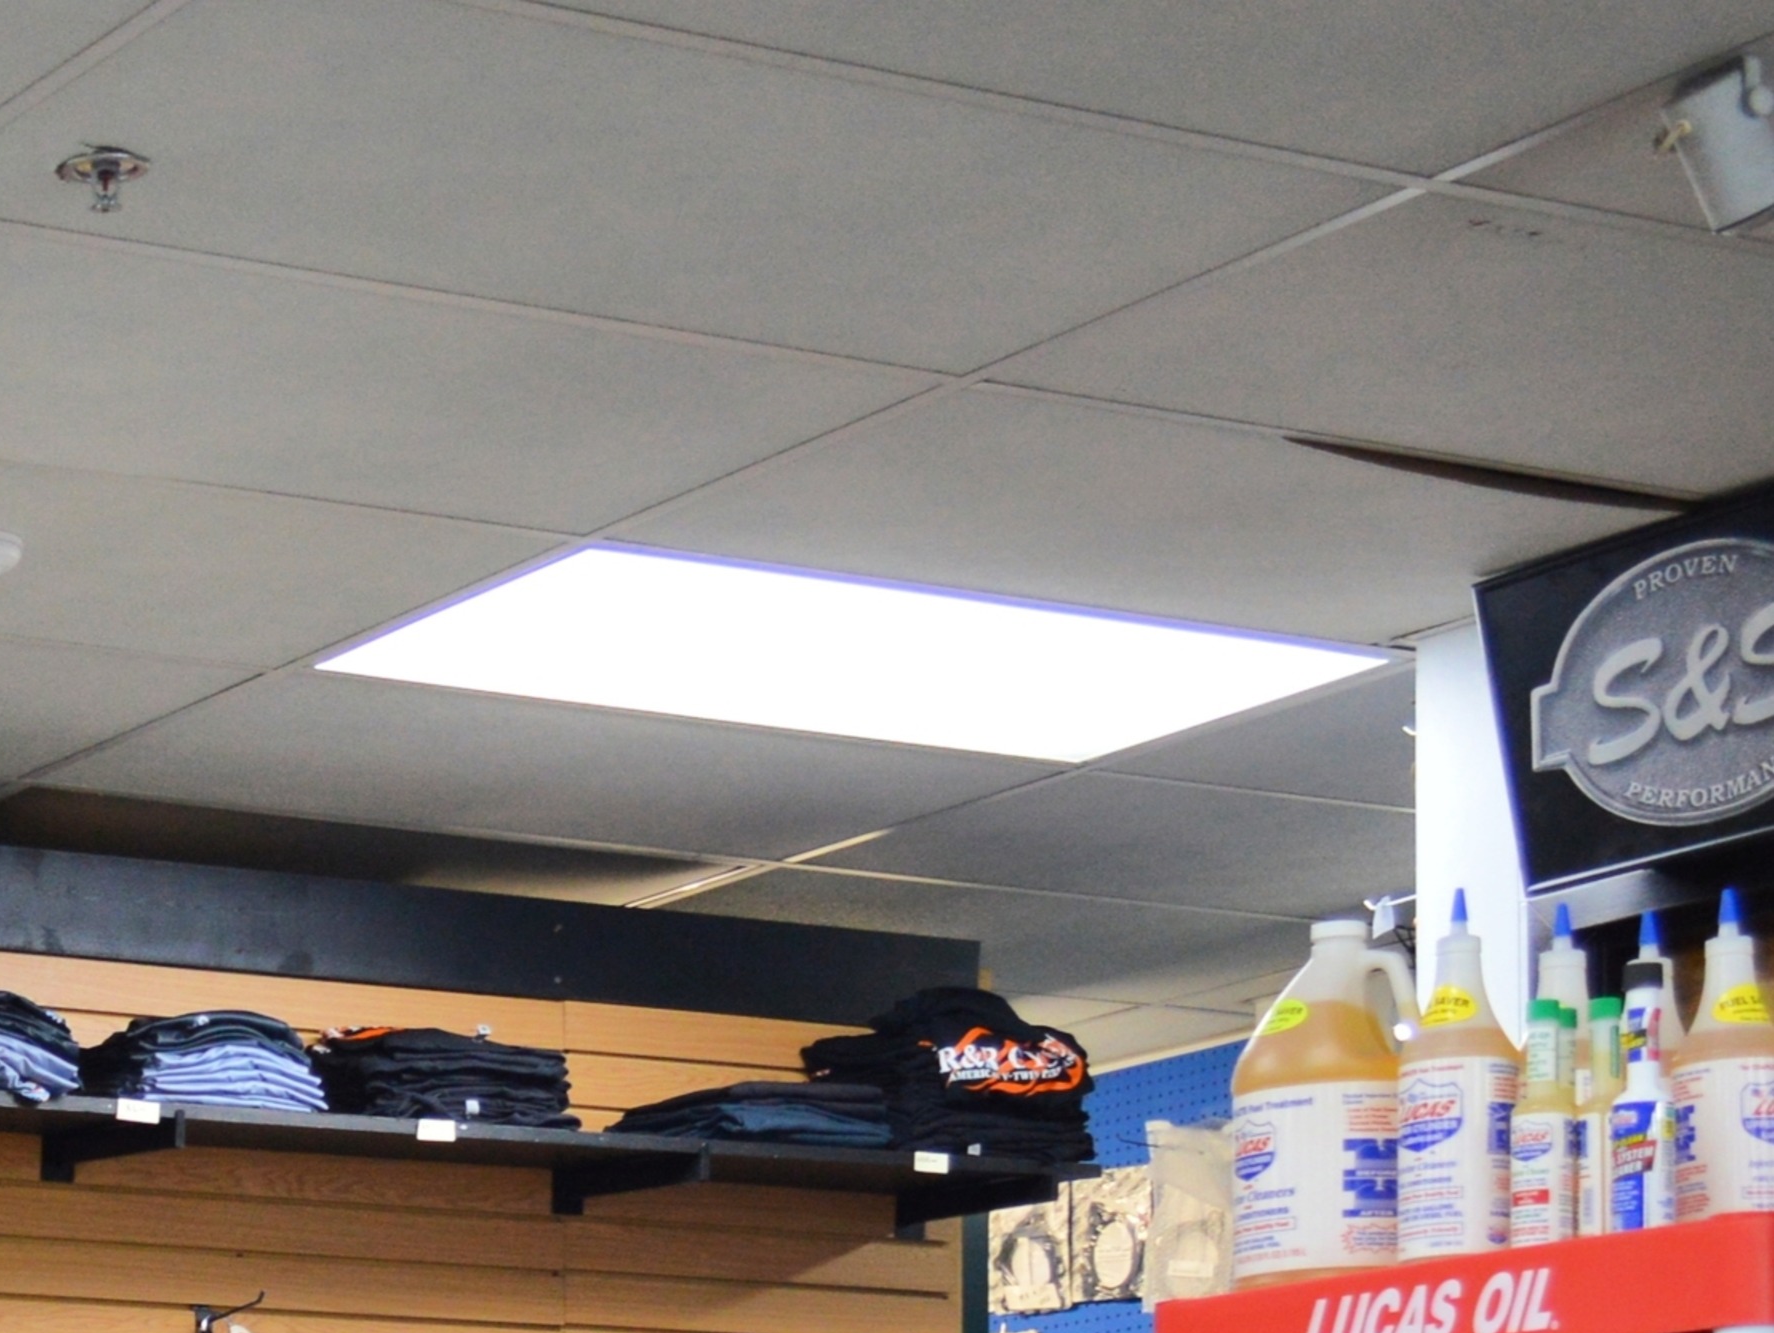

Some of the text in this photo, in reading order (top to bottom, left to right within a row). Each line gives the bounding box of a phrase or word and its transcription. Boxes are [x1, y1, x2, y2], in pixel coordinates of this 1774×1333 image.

[1634, 554, 1738, 600] PROVEN
[937, 1045, 999, 1074] R&R
[1235, 1136, 1273, 1157] UCAS
